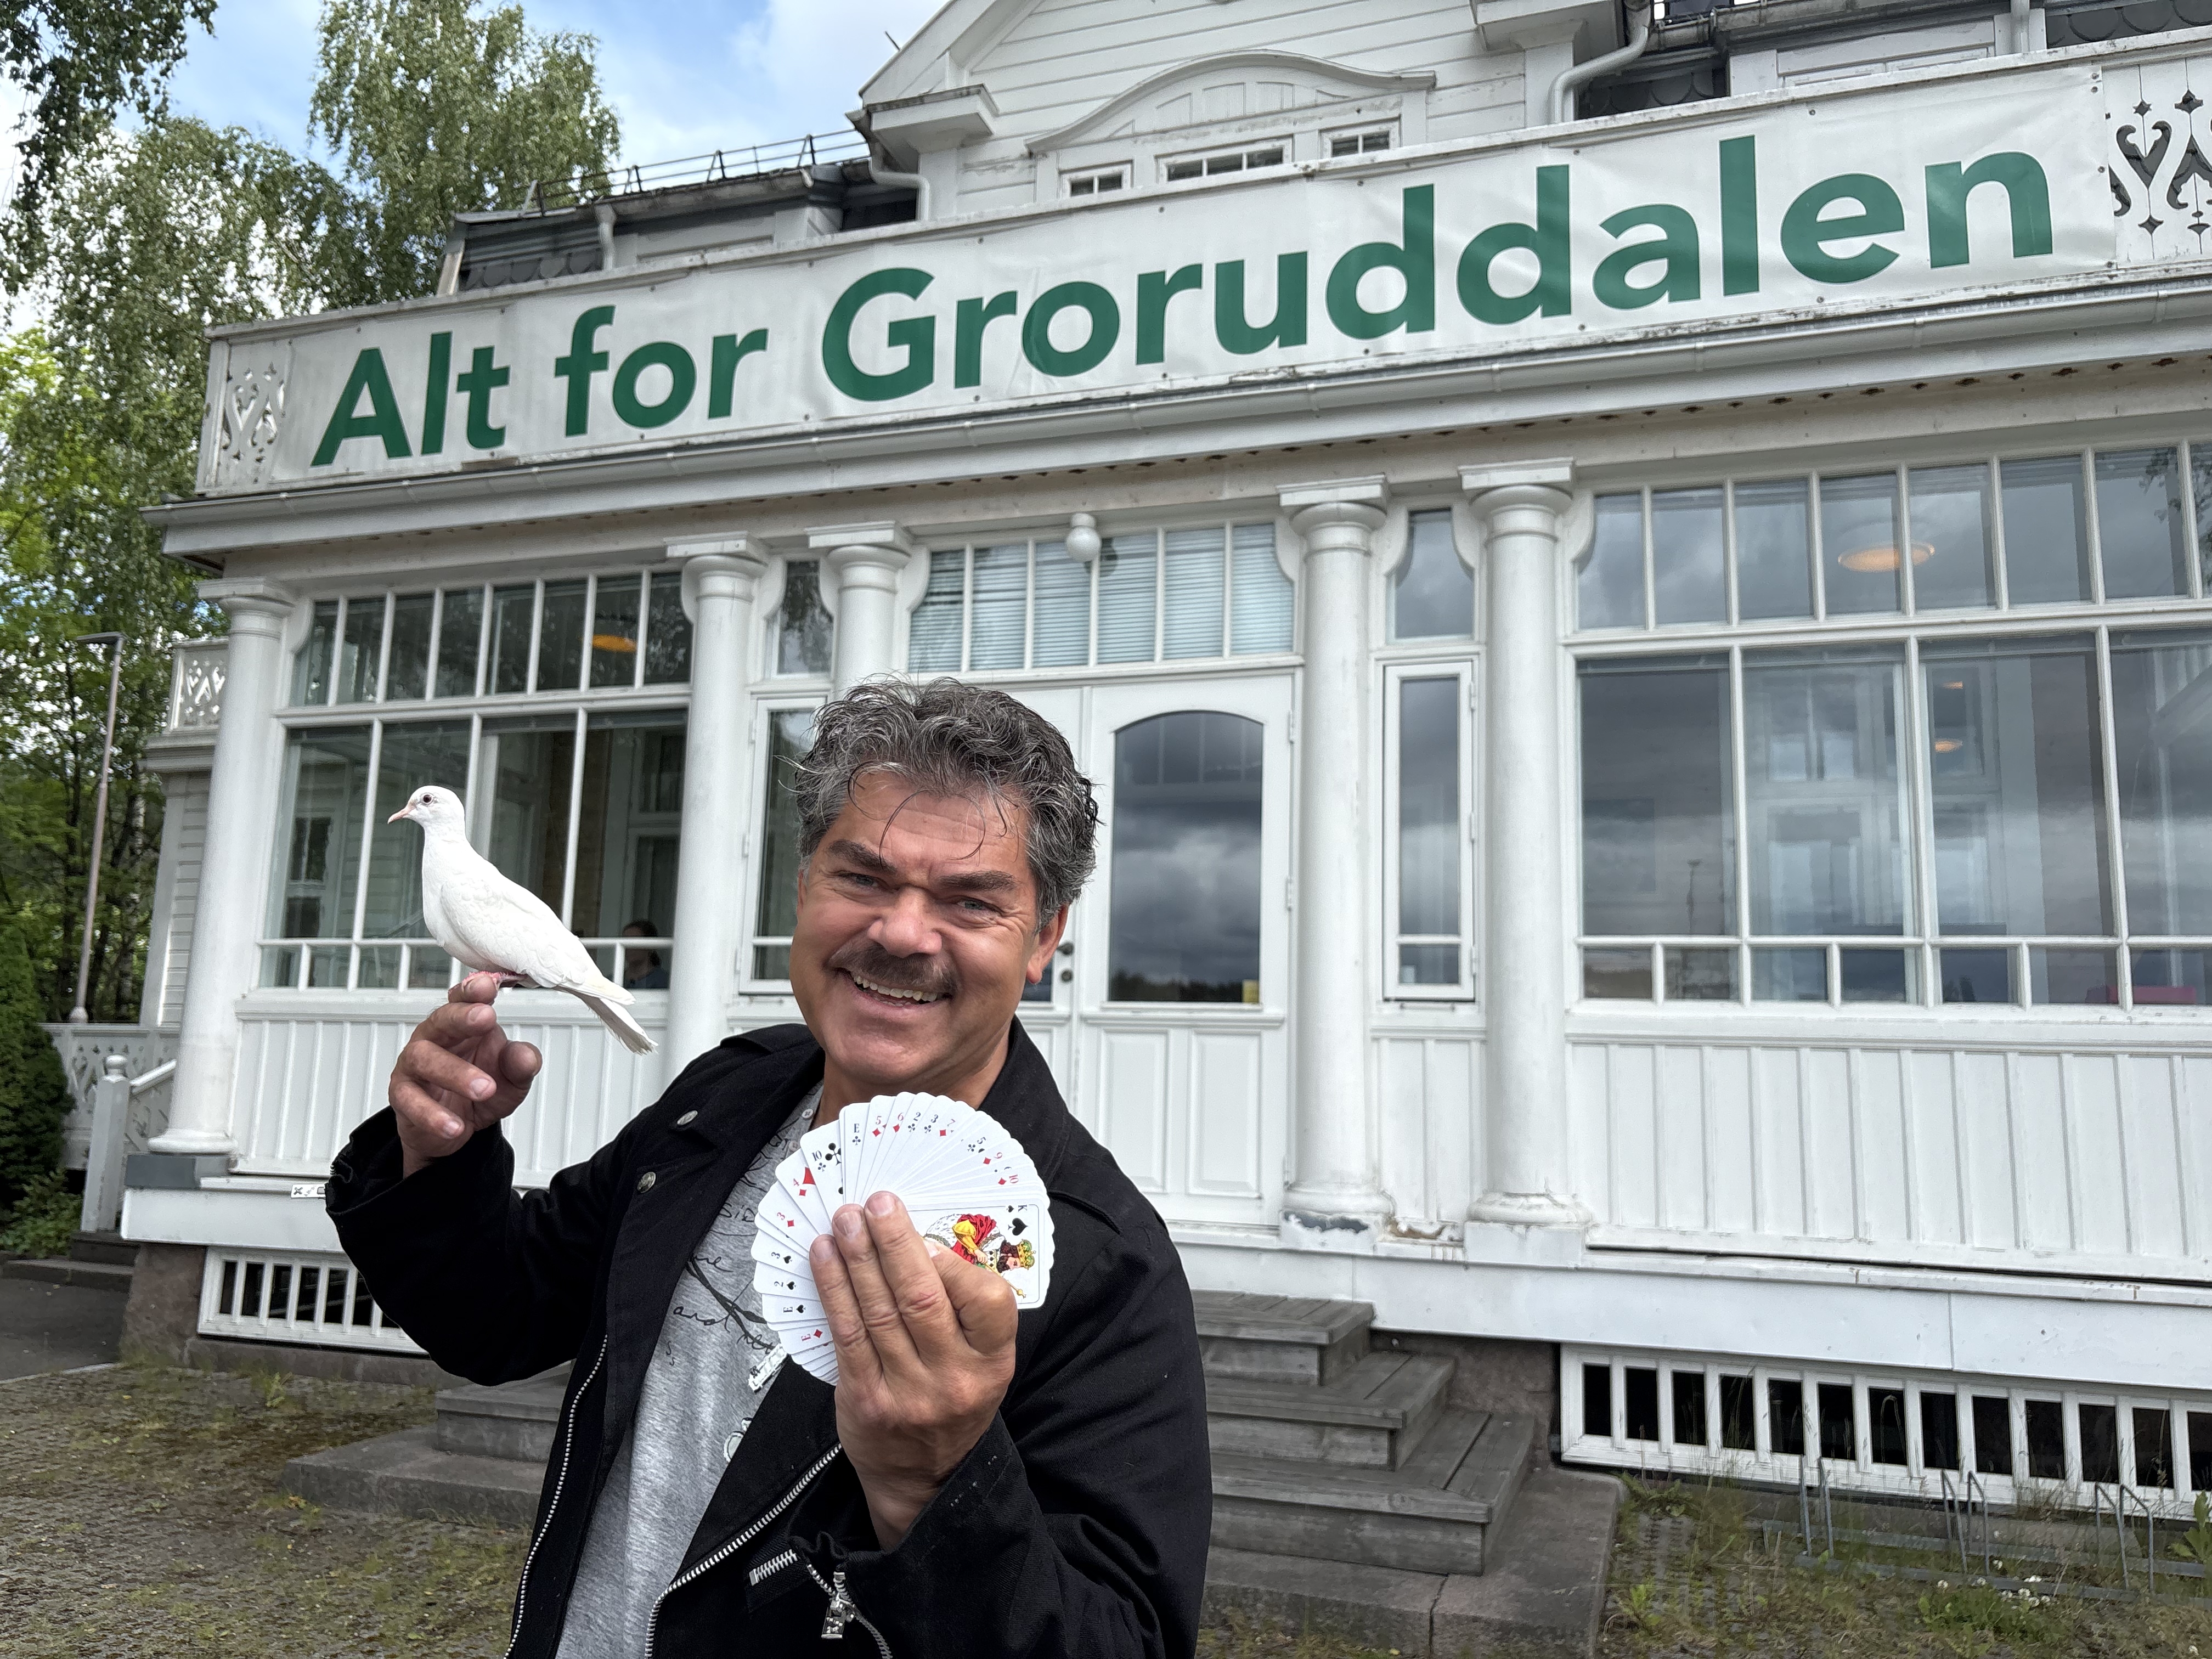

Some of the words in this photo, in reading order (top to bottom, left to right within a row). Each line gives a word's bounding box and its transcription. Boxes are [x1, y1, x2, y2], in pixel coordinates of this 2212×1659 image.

[311, 331, 510, 467] Alt
[554, 304, 769, 437] for
[821, 135, 2053, 402] Groruddalen
[876, 1116, 882, 1125] 5
[898, 1113, 904, 1121] 6
[913, 1111, 921, 1121] 2
[930, 1114, 939, 1123] 3
[854, 1124, 860, 1133] E
[977, 1136, 986, 1145] 5
[812, 1150, 822, 1161] 10
[793, 1178, 800, 1187] 4
[1009, 1174, 1019, 1183] 10
